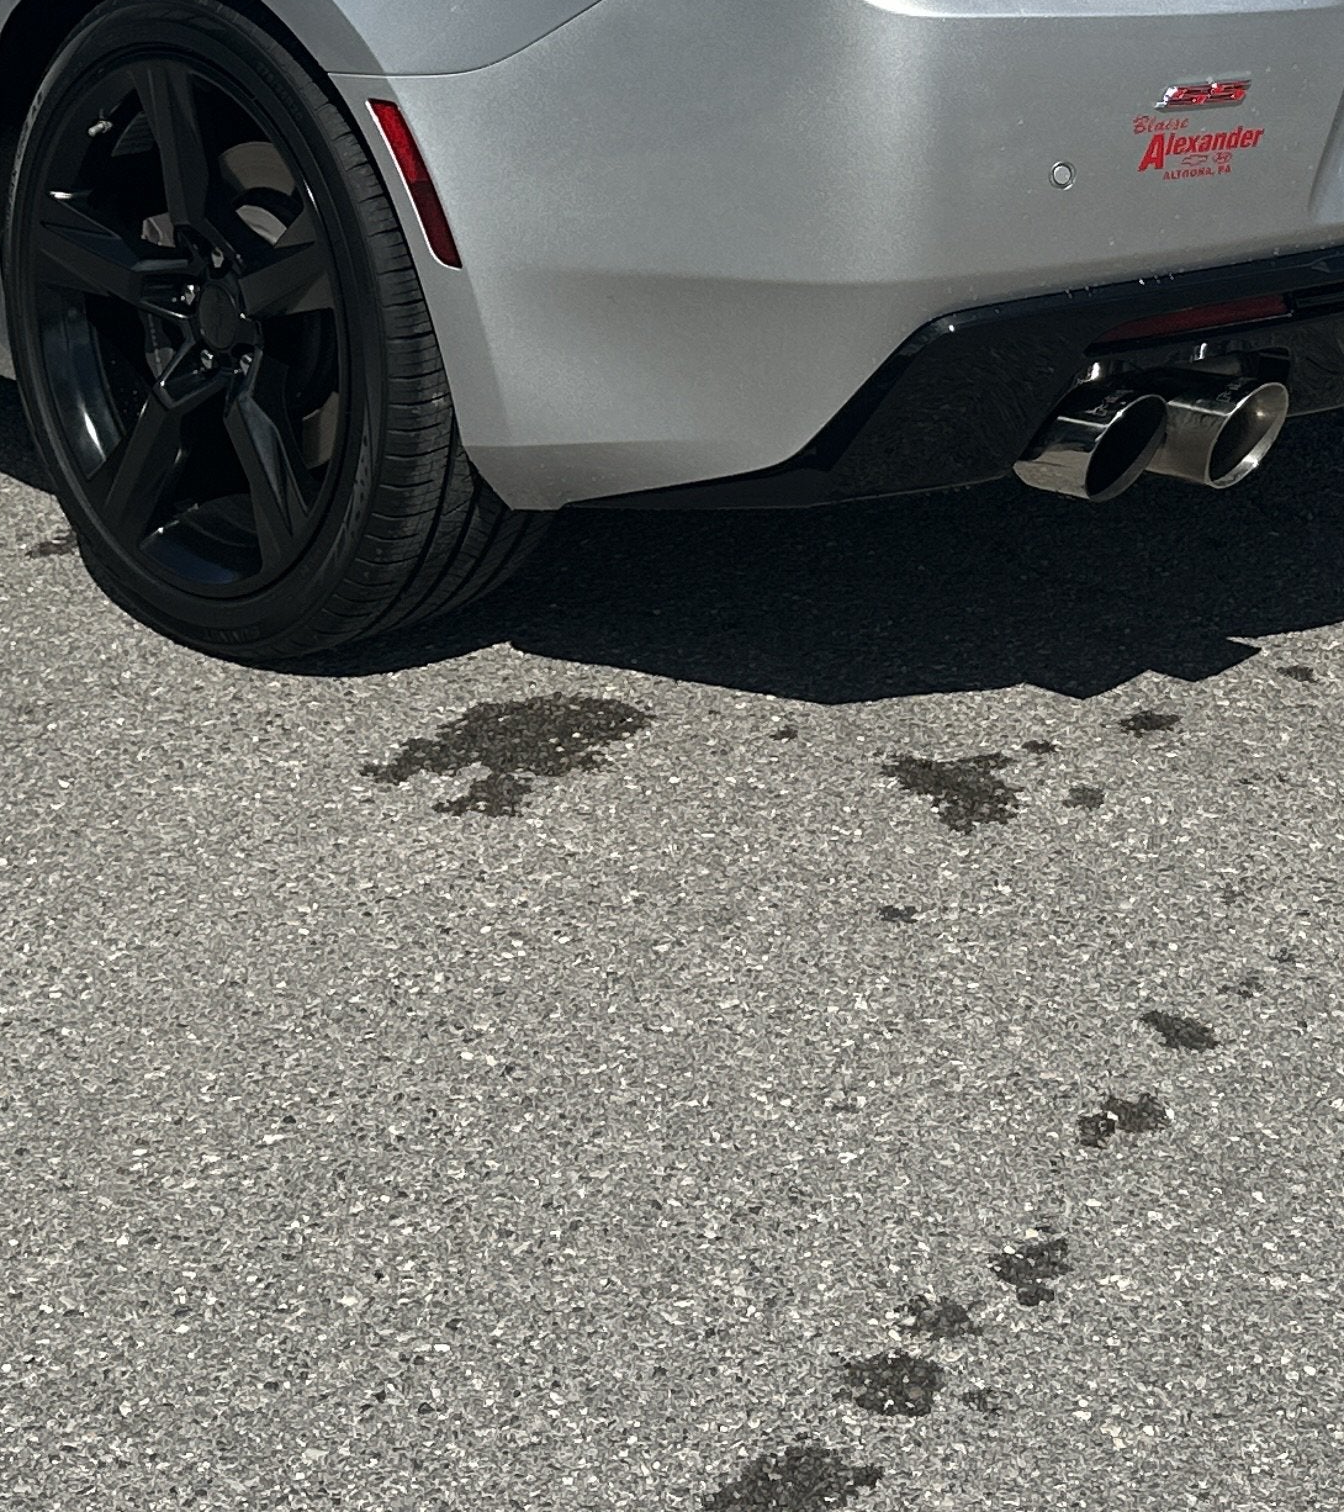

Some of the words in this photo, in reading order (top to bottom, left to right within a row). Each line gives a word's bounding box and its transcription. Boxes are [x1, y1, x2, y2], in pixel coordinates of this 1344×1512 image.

[1132, 115, 1189, 135] Blaise
[1137, 125, 1265, 172] Alexander
[1218, 164, 1232, 175] PA
